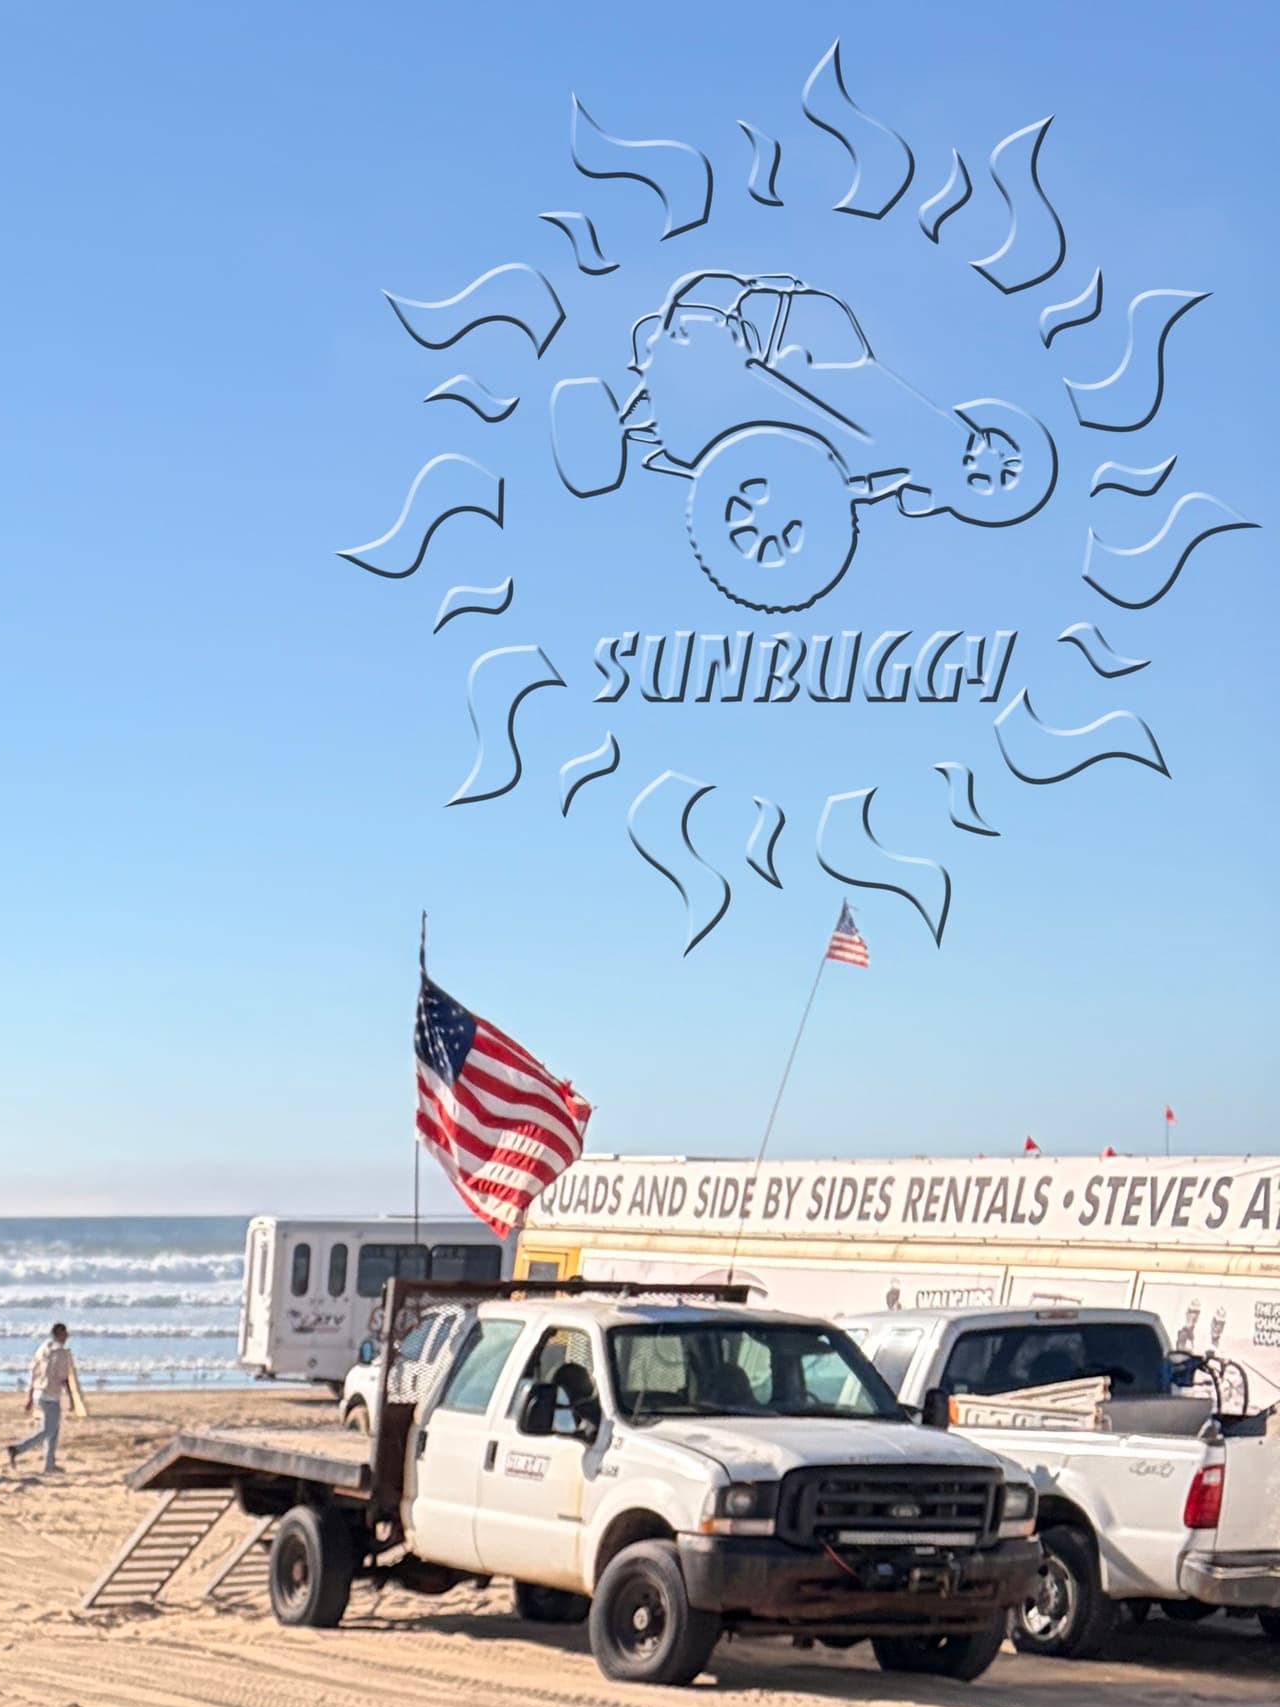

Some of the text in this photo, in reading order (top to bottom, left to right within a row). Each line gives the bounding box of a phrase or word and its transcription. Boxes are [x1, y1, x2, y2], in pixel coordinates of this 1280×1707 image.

[540, 1174, 624, 1217] QUADS
[628, 1175, 688, 1218] AND
[693, 1175, 757, 1219] SIDE
[762, 1176, 804, 1221] BY
[805, 1175, 895, 1222] SIDES
[902, 1175, 1054, 1226] RENTALS
[1078, 1174, 1234, 1230] STEVE'S
